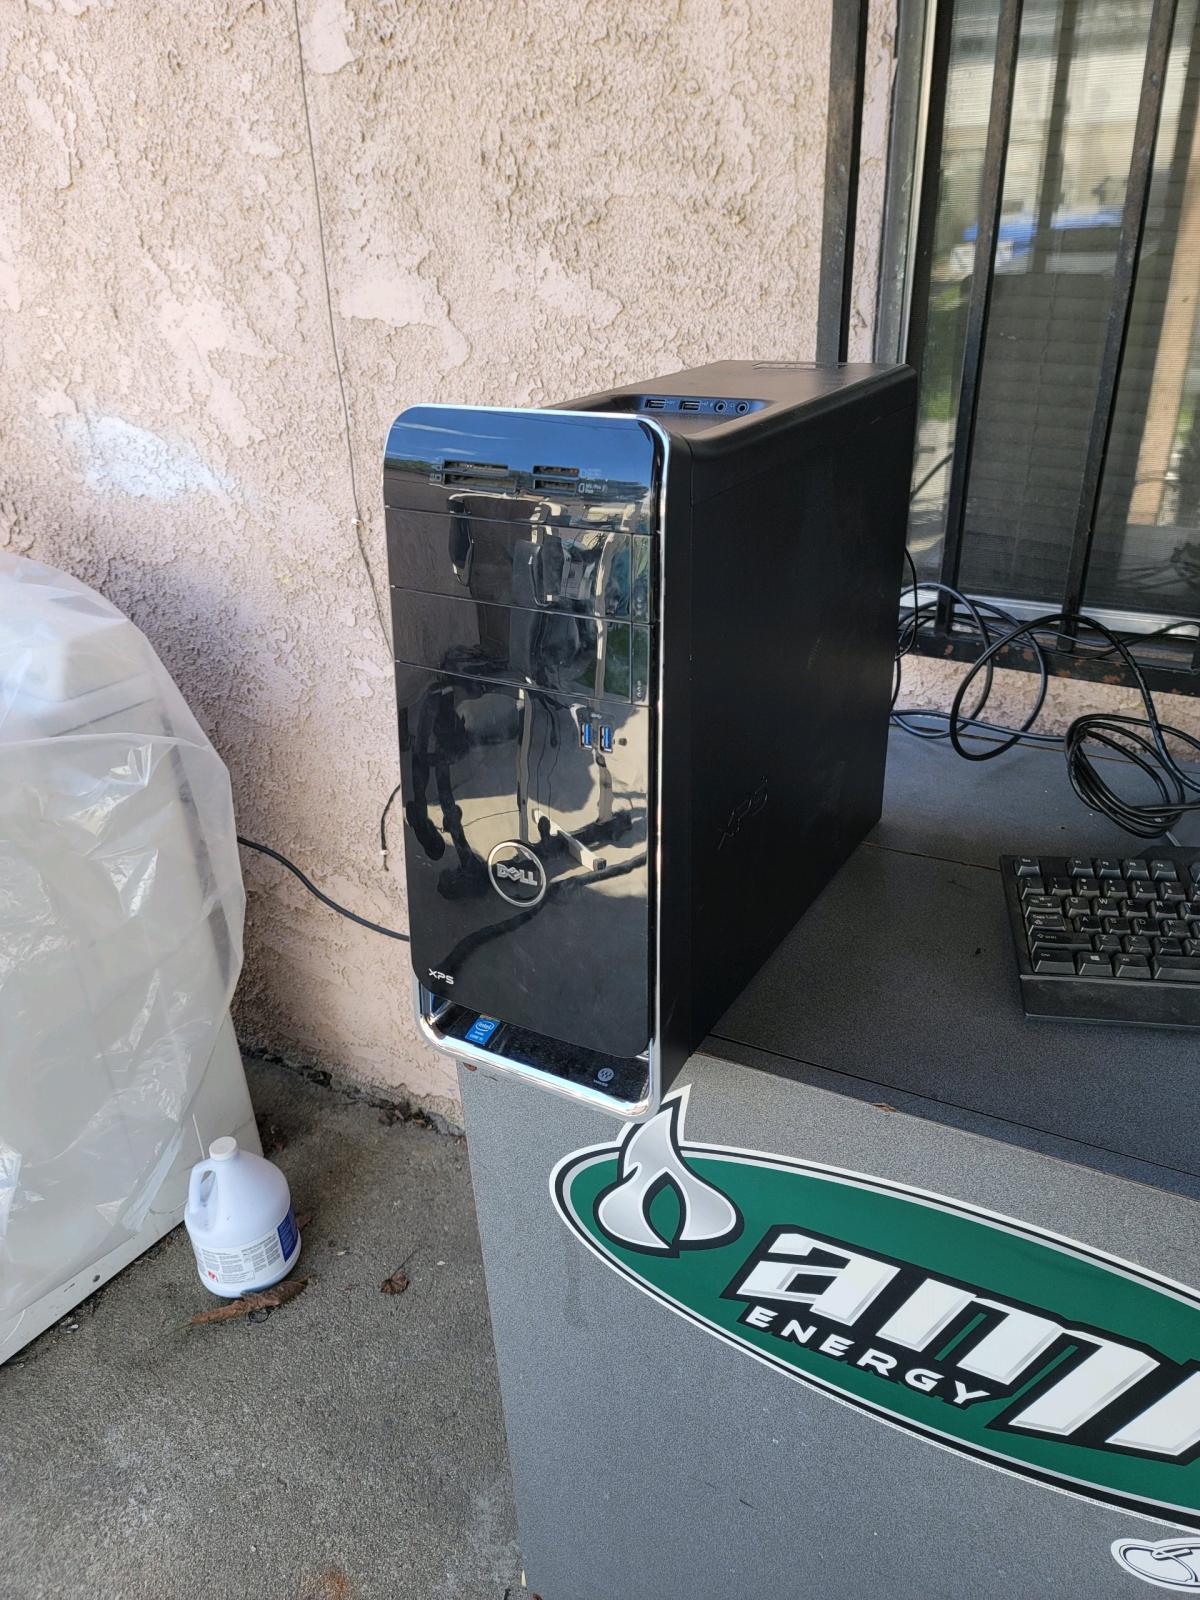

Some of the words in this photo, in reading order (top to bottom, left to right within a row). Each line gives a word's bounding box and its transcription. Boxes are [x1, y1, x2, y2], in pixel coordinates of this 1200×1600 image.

[497, 863, 538, 886] DELL
[428, 968, 454, 985] XPS
[744, 1305, 991, 1405] ENERGY
